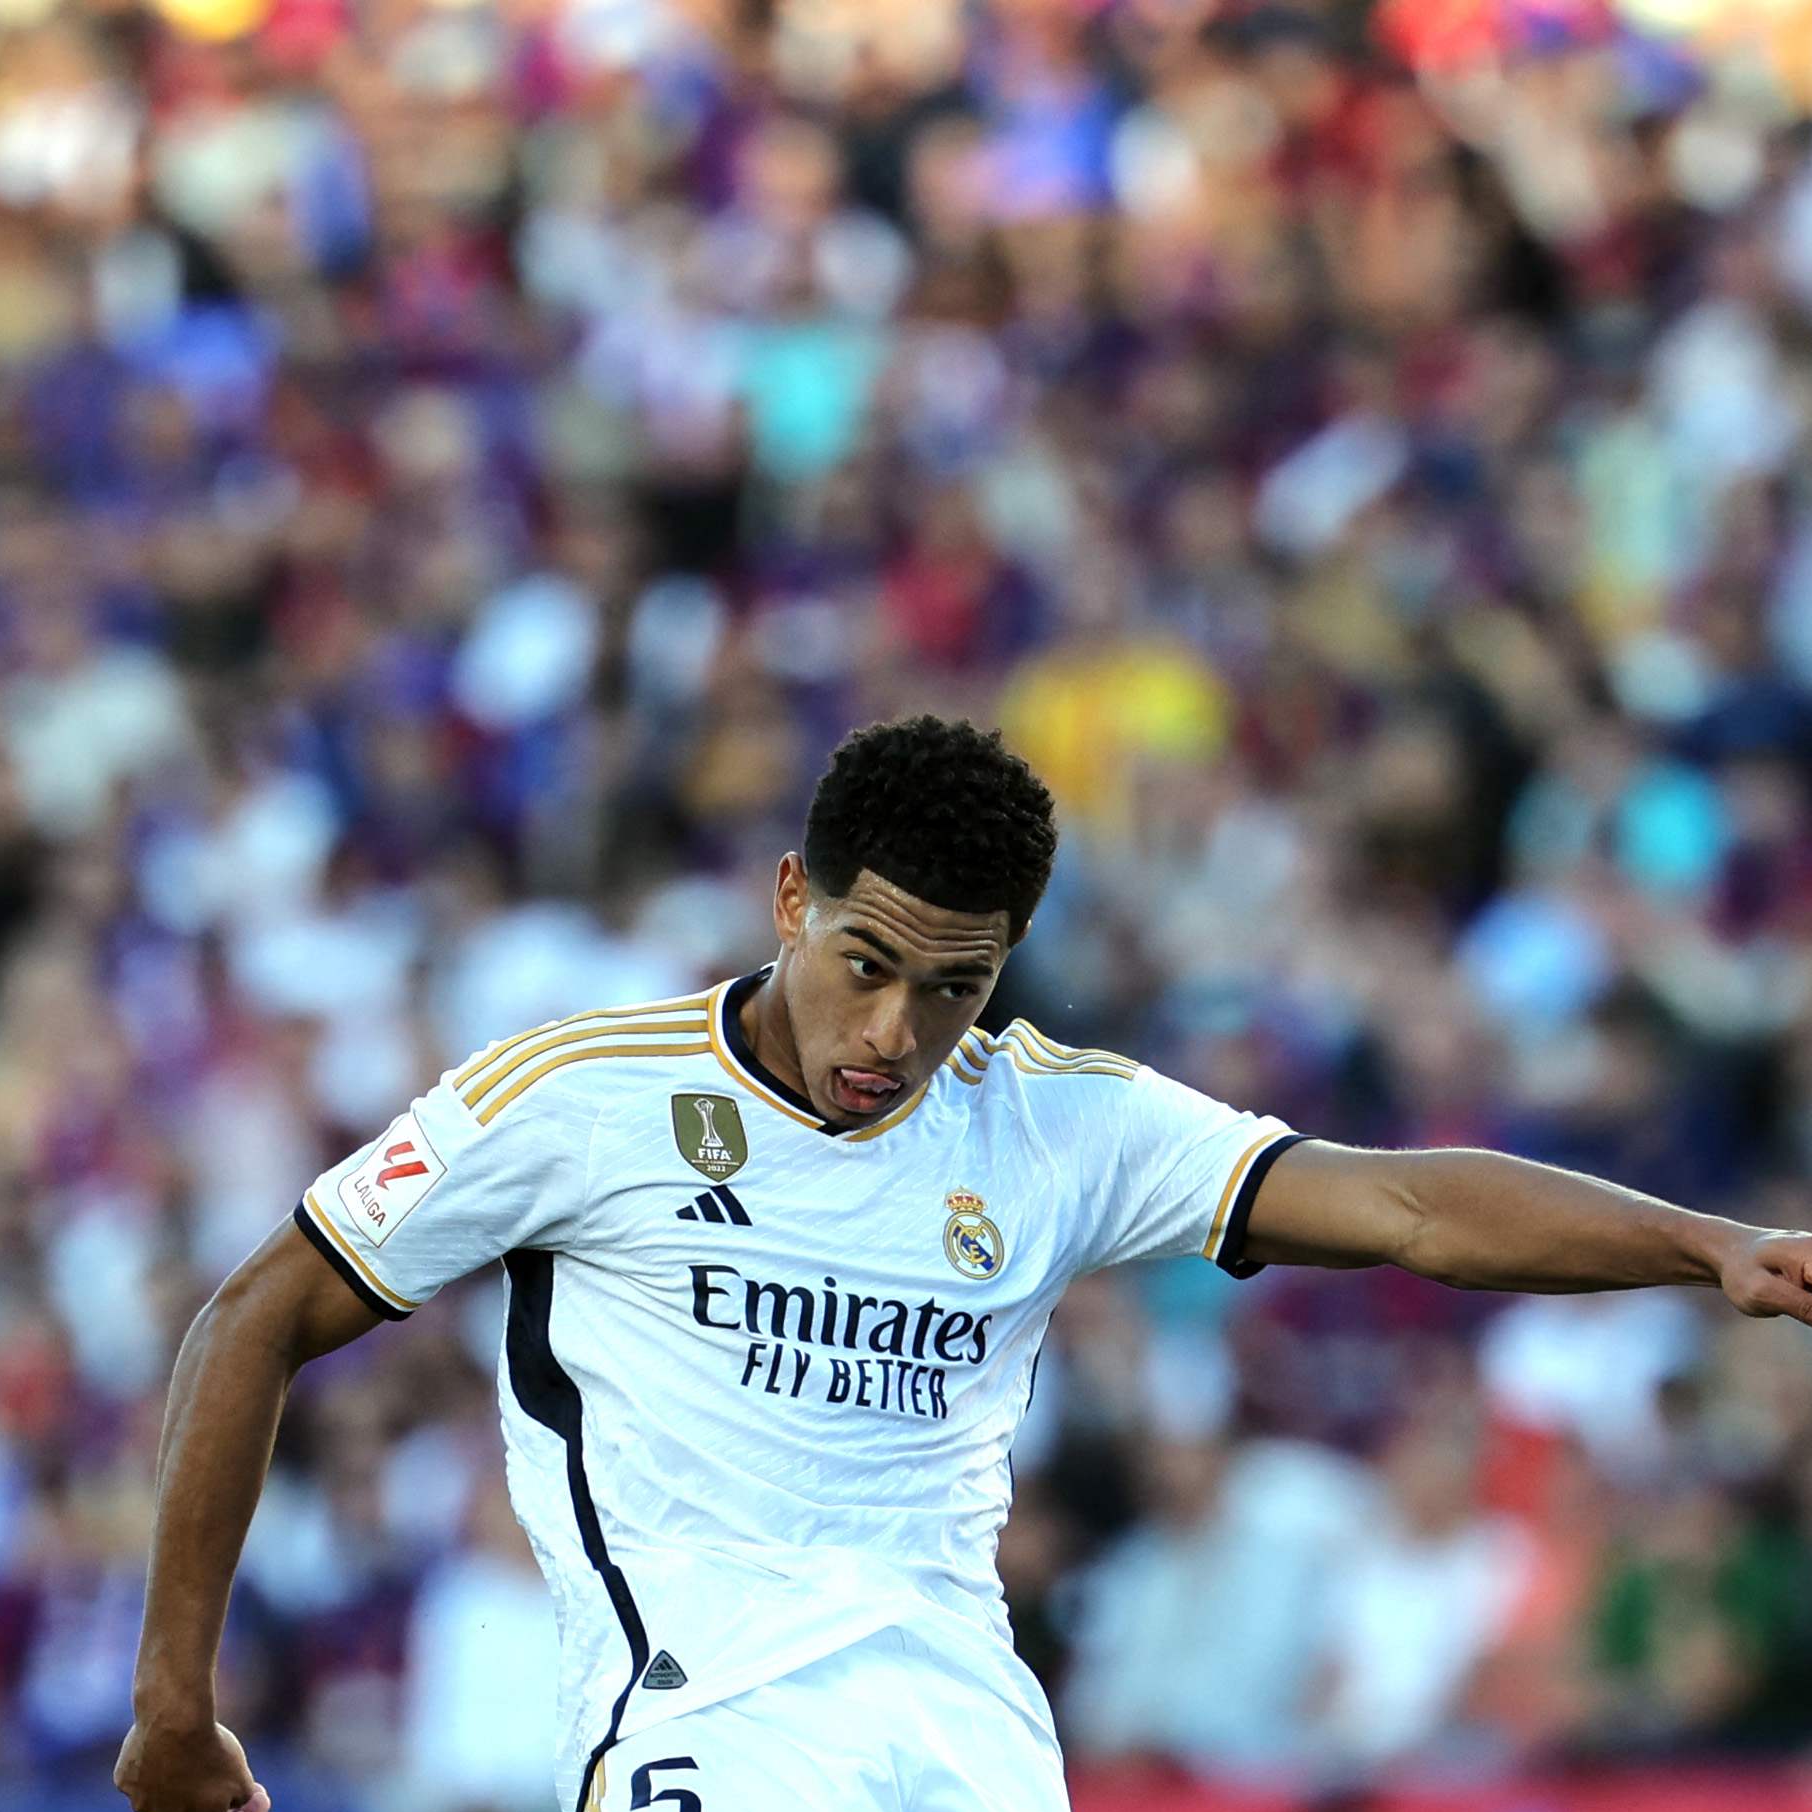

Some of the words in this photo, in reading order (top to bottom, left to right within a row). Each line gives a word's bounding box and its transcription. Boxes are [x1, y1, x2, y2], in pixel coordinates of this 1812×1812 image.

[697, 1147, 731, 1160] FIFA
[353, 1175, 387, 1228] LALIGA
[687, 1264, 993, 1365] Emirates
[739, 1342, 812, 1399] FLY
[825, 1357, 949, 1420] BETTER
